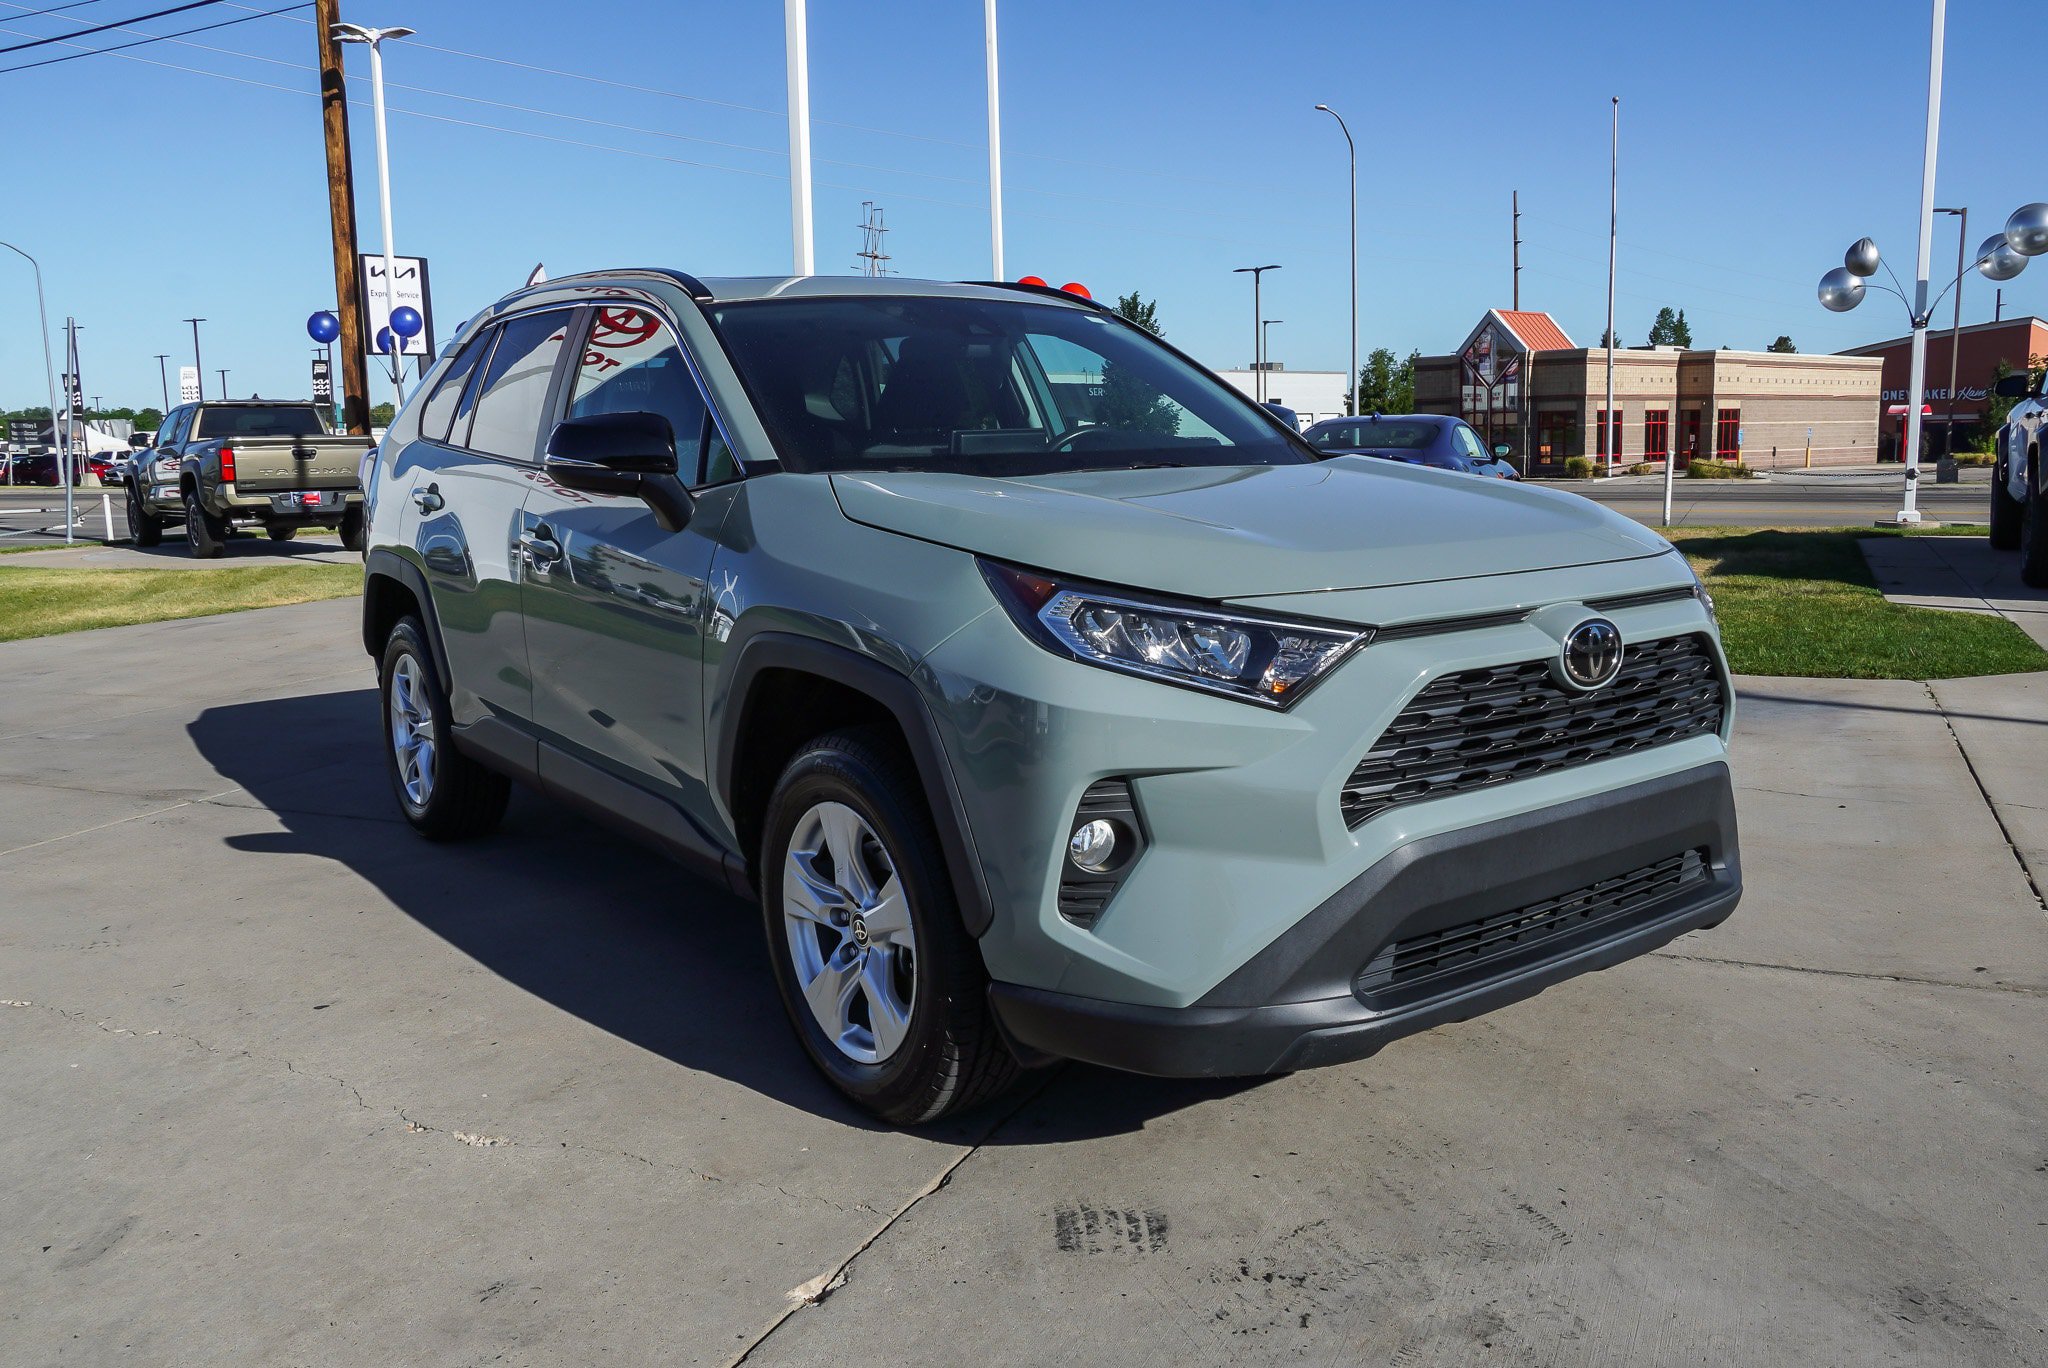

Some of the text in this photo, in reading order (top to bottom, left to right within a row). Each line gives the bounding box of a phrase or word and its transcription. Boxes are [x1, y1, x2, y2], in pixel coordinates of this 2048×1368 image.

[397, 291, 419, 299] Service
[1957, 386, 1988, 401] Ham
[259, 467, 352, 476] TACOMA
